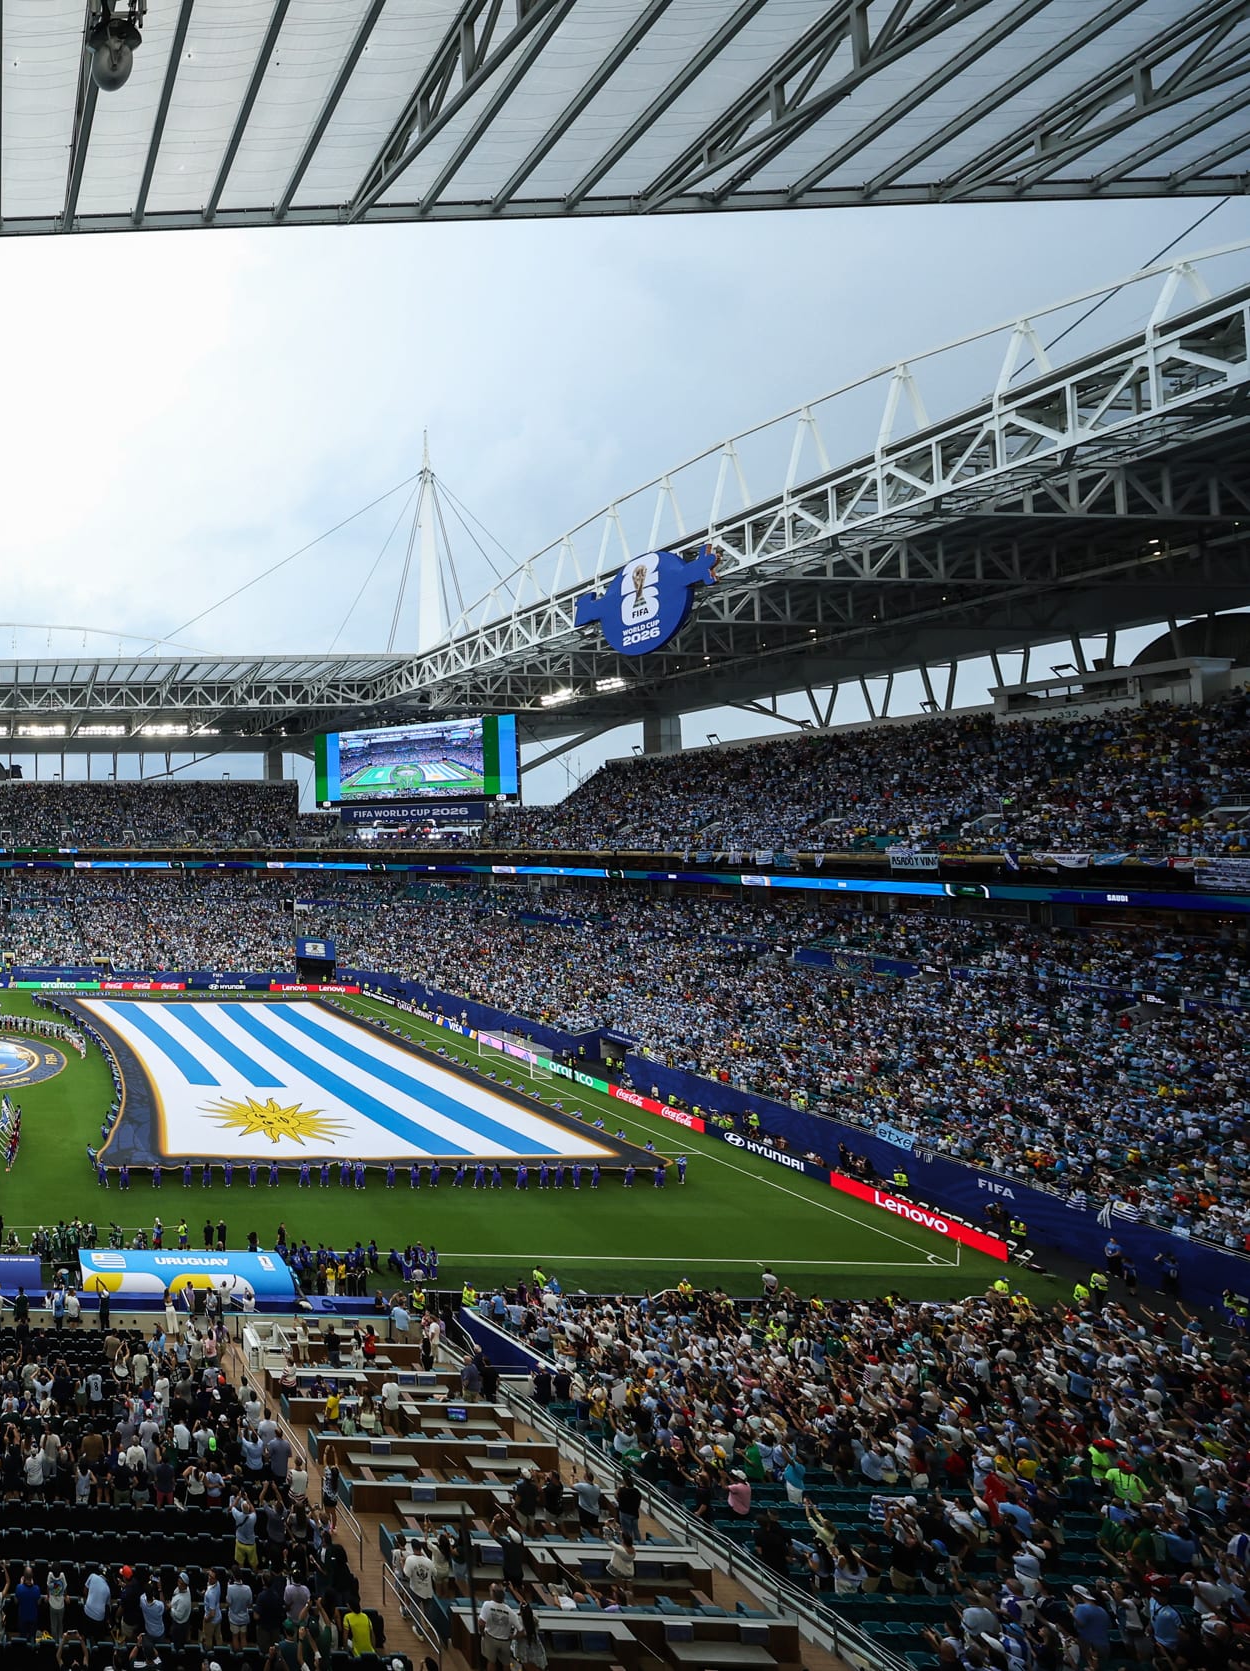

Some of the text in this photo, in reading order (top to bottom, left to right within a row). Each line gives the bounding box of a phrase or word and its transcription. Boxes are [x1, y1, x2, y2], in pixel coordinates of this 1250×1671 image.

[632, 608, 649, 618] FIFA
[622, 619, 660, 636] WORLD CUP
[622, 627, 661, 647] 2026
[353, 807, 469, 818] FIFA WORLD CUP 2026
[449, 1020, 463, 1034] VISA
[747, 1140, 805, 1172] HYUNDAI
[978, 1178, 1015, 1200] FIFA
[874, 1190, 949, 1234] Lenovo
[155, 1256, 228, 1266] URUGUAY
